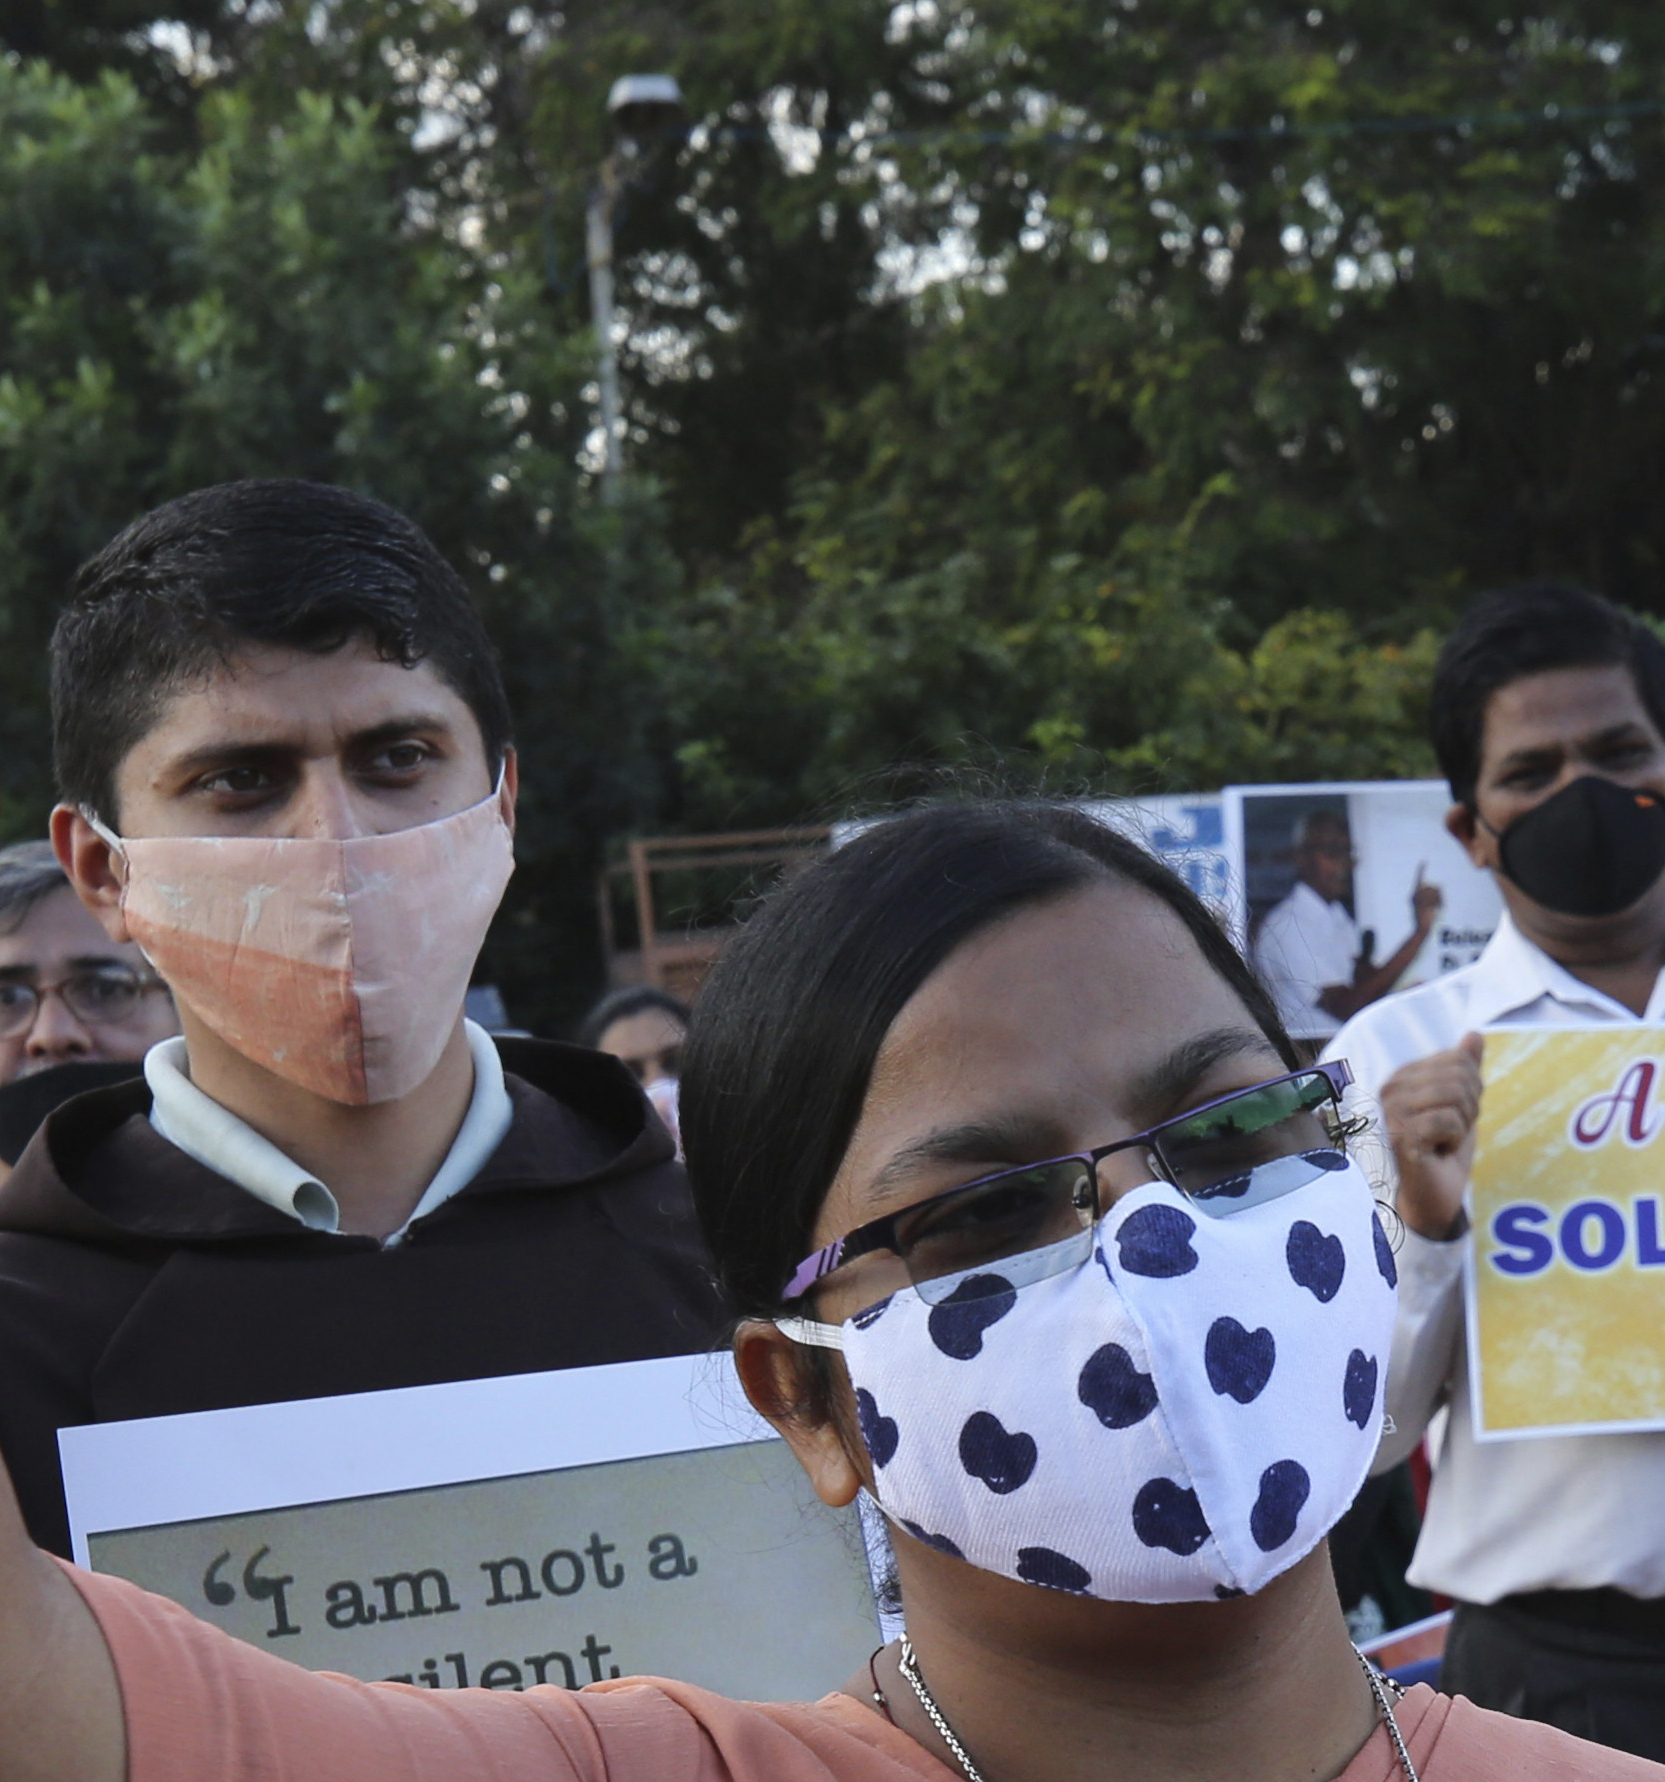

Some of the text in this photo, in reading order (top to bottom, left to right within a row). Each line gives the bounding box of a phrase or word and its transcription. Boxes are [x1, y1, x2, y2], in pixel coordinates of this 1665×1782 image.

[1574, 1061, 1656, 1145] A
[324, 1567, 461, 1631] am
[478, 1532, 625, 1607] not
[647, 1532, 698, 1581] a
